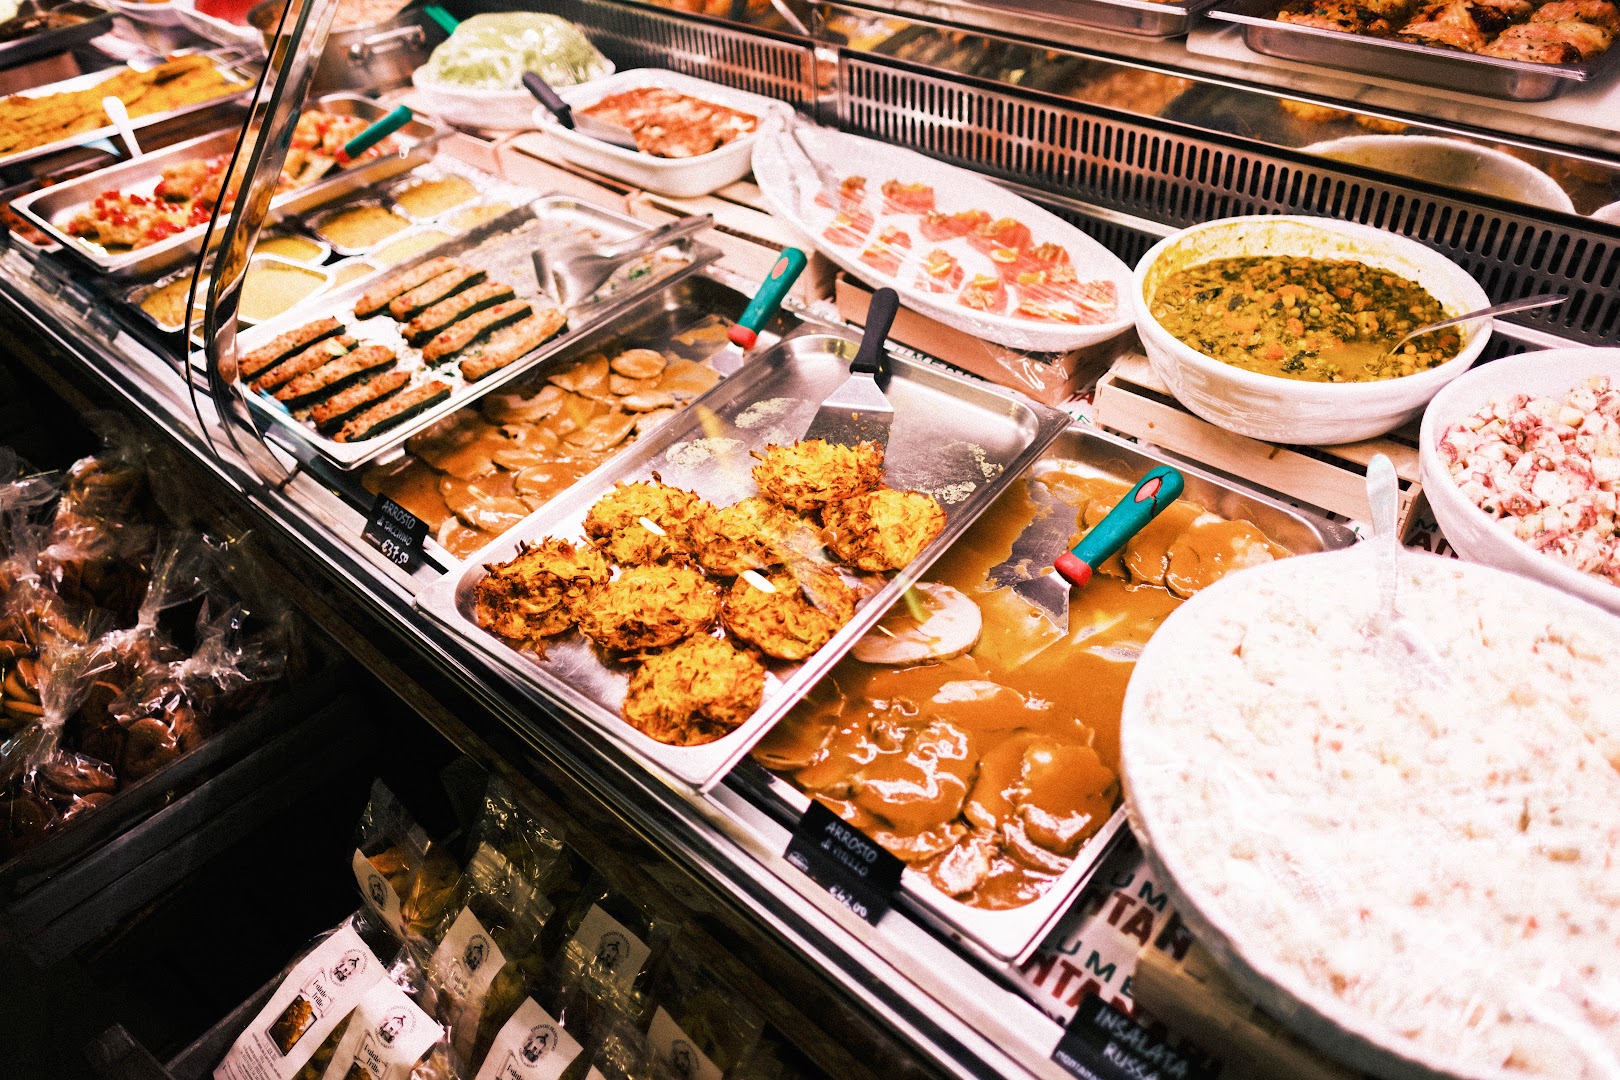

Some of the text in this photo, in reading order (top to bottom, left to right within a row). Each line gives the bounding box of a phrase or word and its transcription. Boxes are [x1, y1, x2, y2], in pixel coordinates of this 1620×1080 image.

[381, 500, 416, 530] ARROSTO
[825, 821, 878, 862] ARROSTO
[1094, 1006, 1188, 1079] INSALATA
